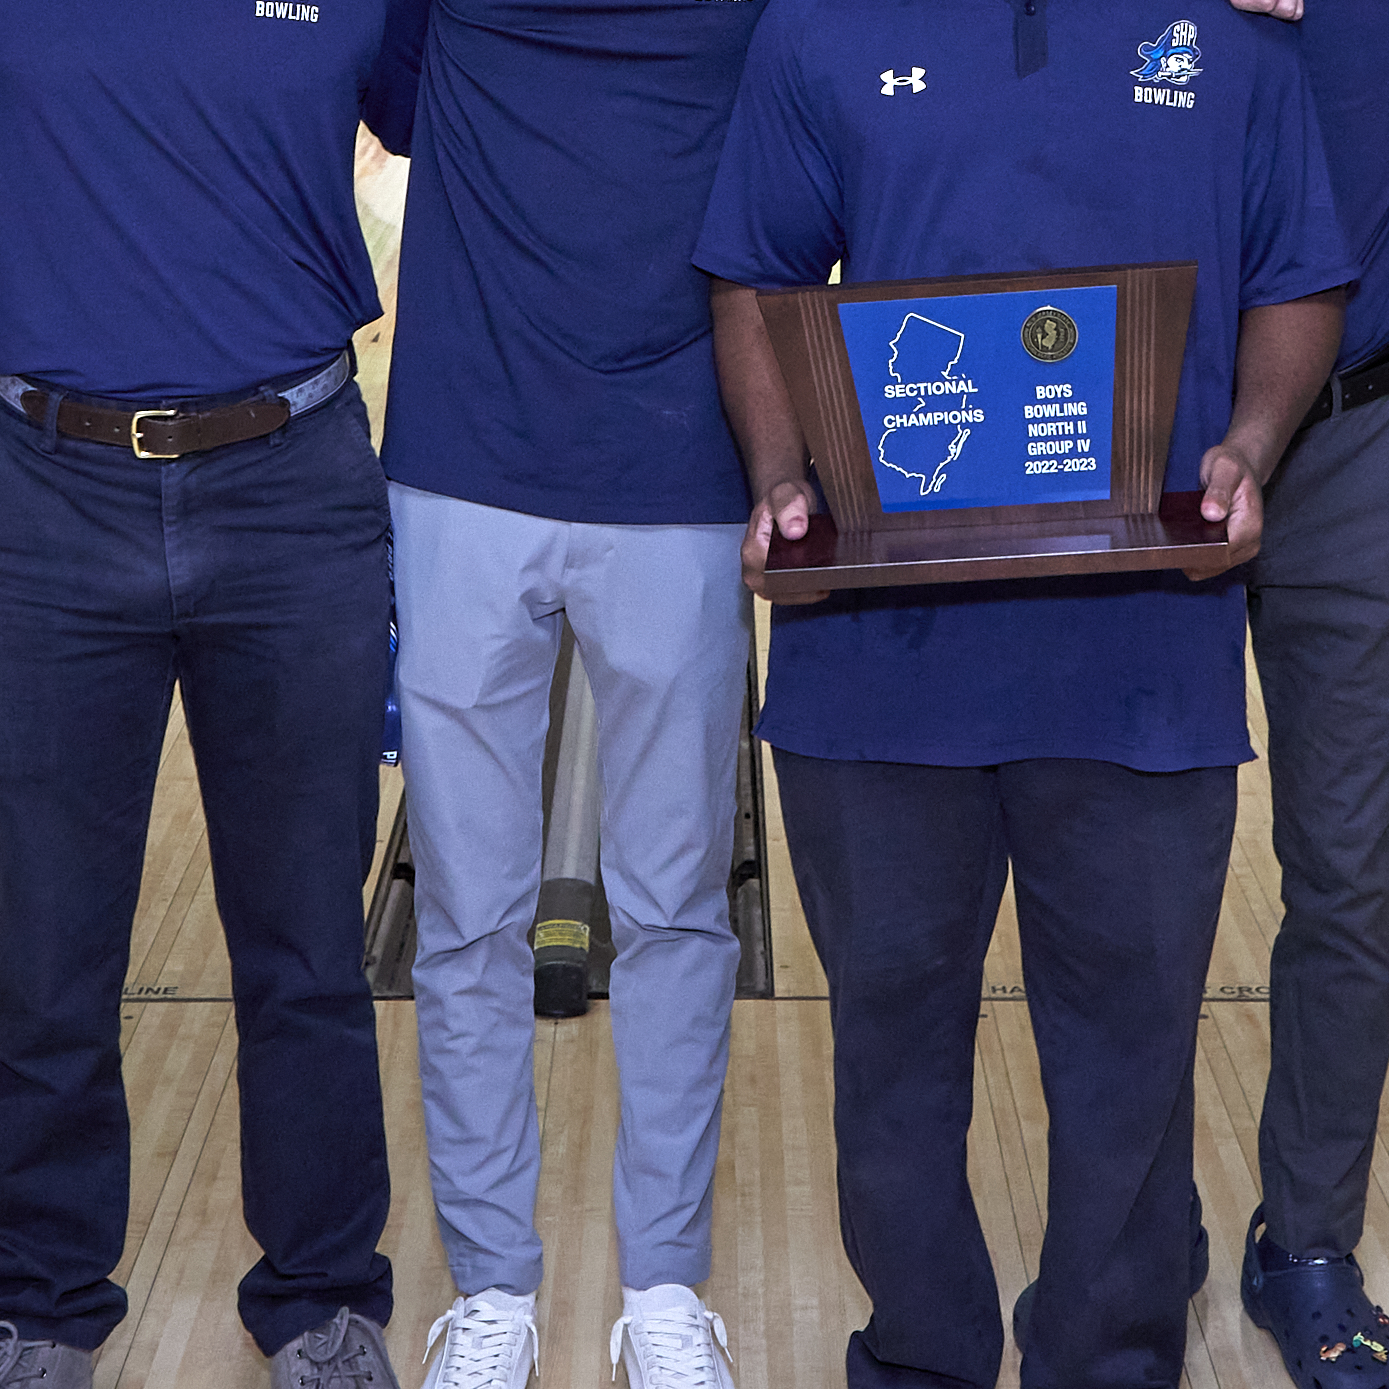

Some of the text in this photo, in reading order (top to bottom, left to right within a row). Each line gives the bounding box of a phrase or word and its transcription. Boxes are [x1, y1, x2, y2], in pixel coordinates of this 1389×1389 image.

[254, 0, 320, 23] BOWLING
[1171, 22, 1195, 47] SHP
[1133, 85, 1196, 109] BOWLING
[884, 379, 979, 399] SECTIONAL
[1035, 383, 1073, 400] BOYS
[883, 408, 985, 429] CHAMPIONS
[1023, 401, 1088, 419] BOWLING
[1027, 420, 1087, 438] NORTH II
[1027, 438, 1091, 456] GROUP IV
[1024, 456, 1097, 475] 2022-2023
[123, 986, 179, 995] LINE
[1219, 986, 1270, 995] CRO
